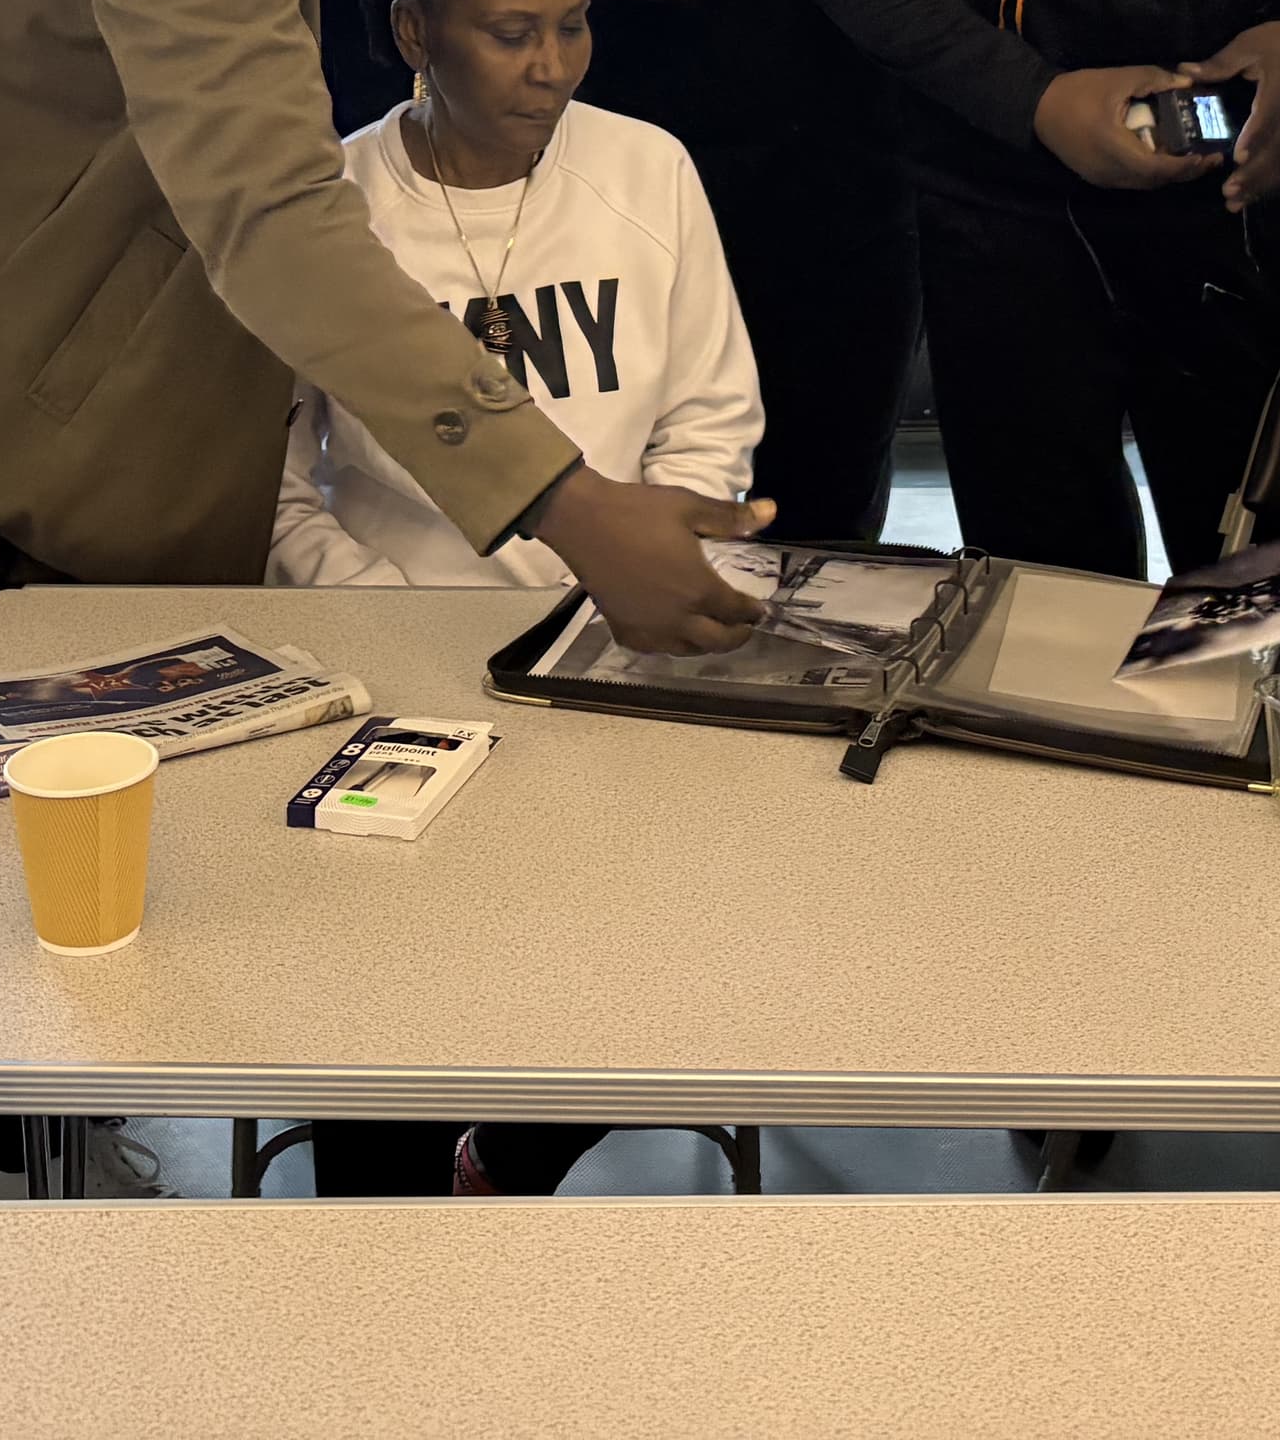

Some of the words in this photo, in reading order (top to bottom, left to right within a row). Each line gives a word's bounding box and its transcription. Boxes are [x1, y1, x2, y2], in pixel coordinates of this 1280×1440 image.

[436, 277, 620, 399] NY
[238, 679, 331, 708] last
[341, 743, 366, 756] 8
[373, 743, 438, 758] Ballpoint
